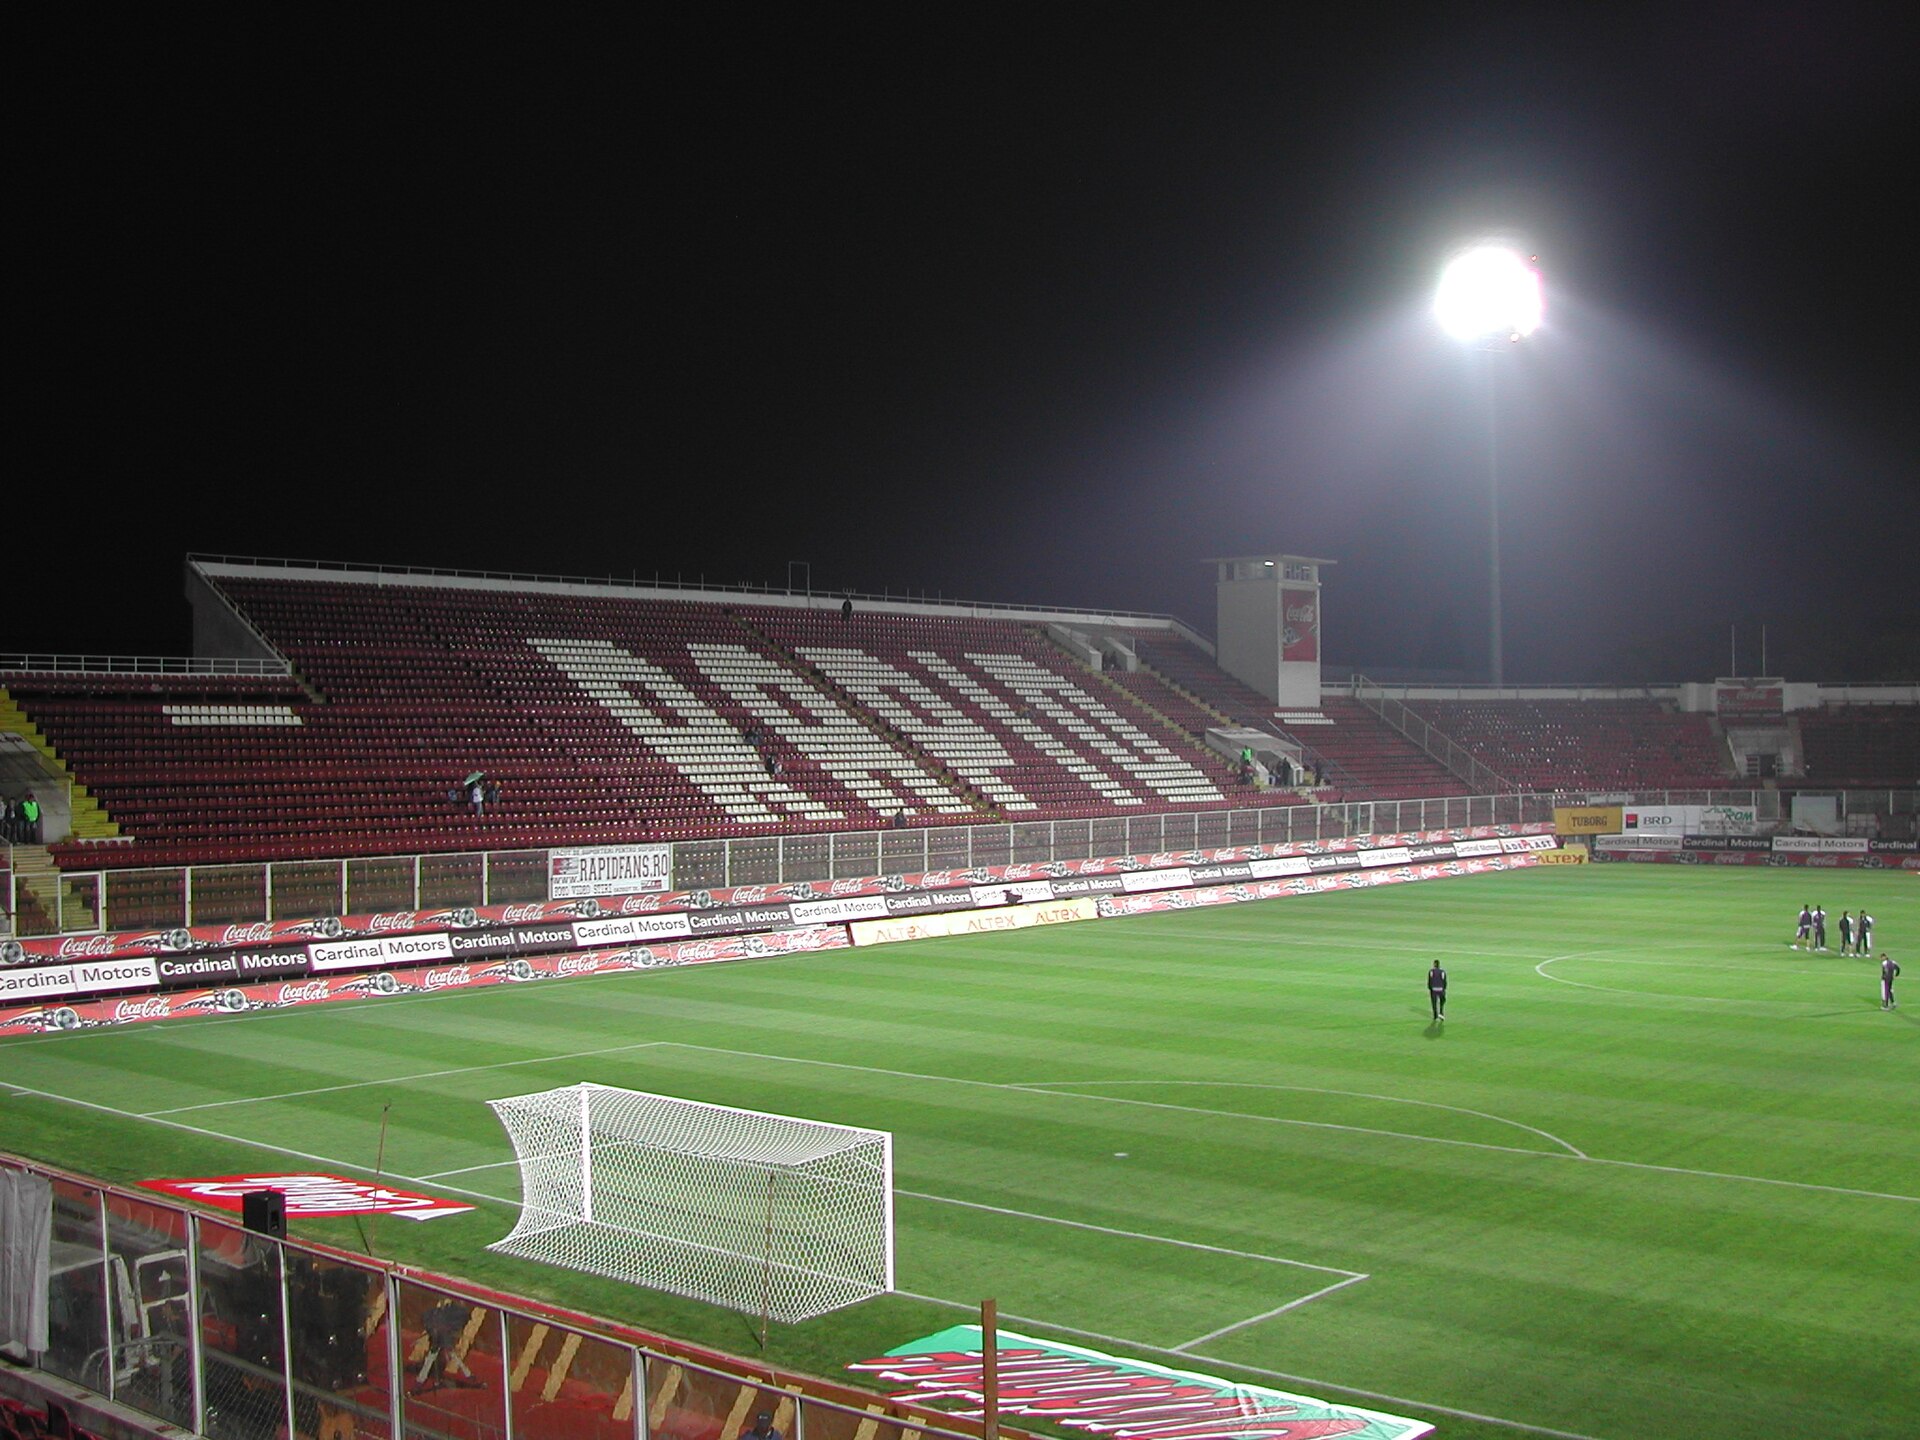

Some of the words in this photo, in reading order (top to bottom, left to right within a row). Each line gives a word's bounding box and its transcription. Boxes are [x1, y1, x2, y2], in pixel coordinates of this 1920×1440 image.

[527, 638, 1226, 824] RAPID
[1571, 816, 1607, 827] TUBORG
[1643, 816, 1672, 825] BRD
[1598, 838, 1639, 847] Cardinal
[1643, 838, 1679, 846] Motors
[1684, 838, 1727, 847] Cardinal
[1730, 839, 1770, 847] Motors
[1775, 839, 1820, 847] Cardinal
[1824, 840, 1864, 848] Motors
[1869, 841, 1917, 849] Cardinal
[1191, 867, 1222, 880] Cardinal
[1016, 885, 1051, 897] Motors
[1051, 879, 1089, 893] Cardinal
[1090, 877, 1122, 891] Motors
[793, 902, 842, 919] Cardinal
[844, 899, 884, 913] Motors
[886, 894, 931, 910] Cardinal
[933, 892, 973, 906] Motors
[577, 921, 635, 938] Cardinal
[638, 917, 687, 933] Motors
[689, 911, 743, 929] Cardinal
[744, 909, 790, 924] Motors
[451, 932, 515, 950] Cardinal
[519, 929, 573, 945] Motors
[314, 943, 384, 962] Cardinal
[388, 939, 446, 955] Motors
[160, 956, 237, 976] Cardinal
[242, 951, 308, 970] Motors
[0, 969, 75, 991] ardinal
[82, 965, 152, 982] Motors
